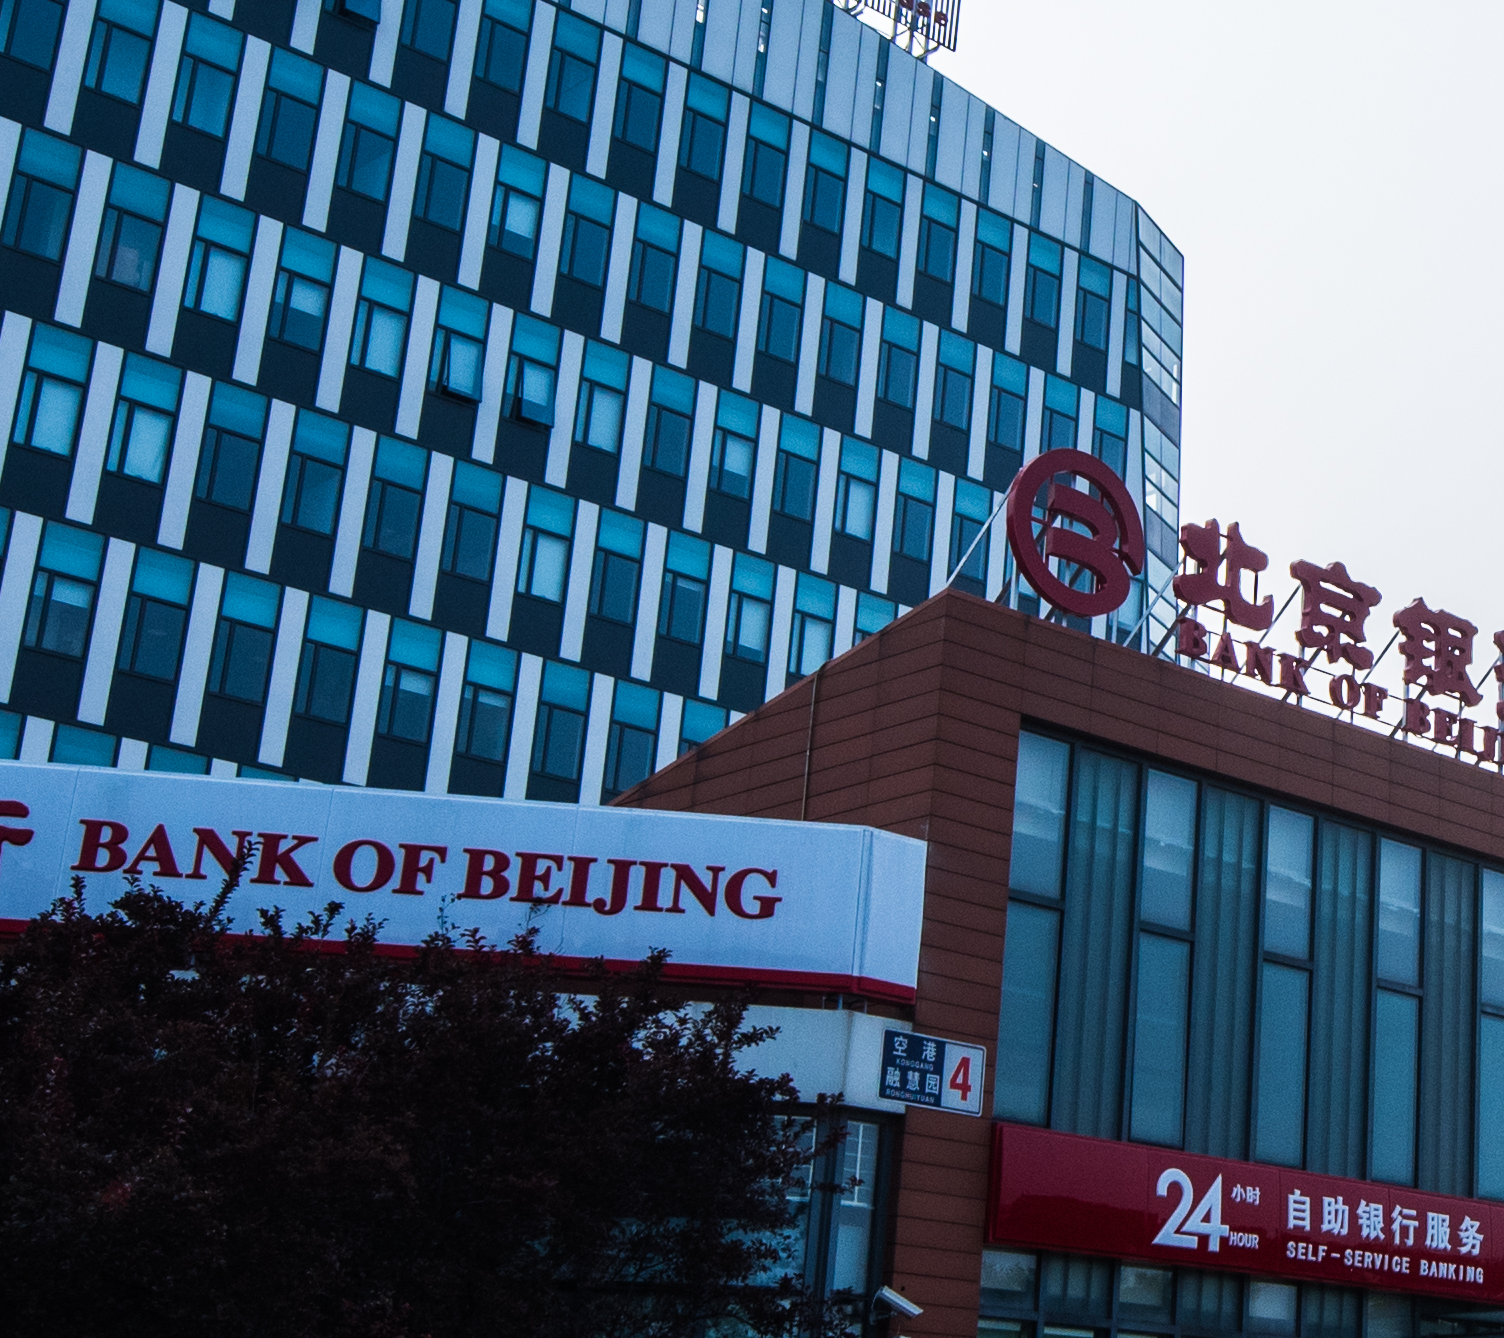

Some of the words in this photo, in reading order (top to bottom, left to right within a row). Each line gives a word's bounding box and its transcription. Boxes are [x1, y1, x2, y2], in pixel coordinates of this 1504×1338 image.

[1174, 618, 1310, 697] BANK
[1329, 673, 1389, 720] OF
[71, 818, 318, 888] BANK
[333, 838, 448, 896] OF
[457, 847, 783, 920] BEIJING
[892, 1035, 937, 1062] 空港
[949, 1056, 972, 1102] 4
[1151, 1167, 1230, 1253] 24
[1231, 1183, 1260, 1206] 小时
[1286, 1189, 1485, 1257] 自助银行服务
[1229, 1231, 1259, 1250] HOUR
[1419, 1260, 1485, 1285] BANKING
